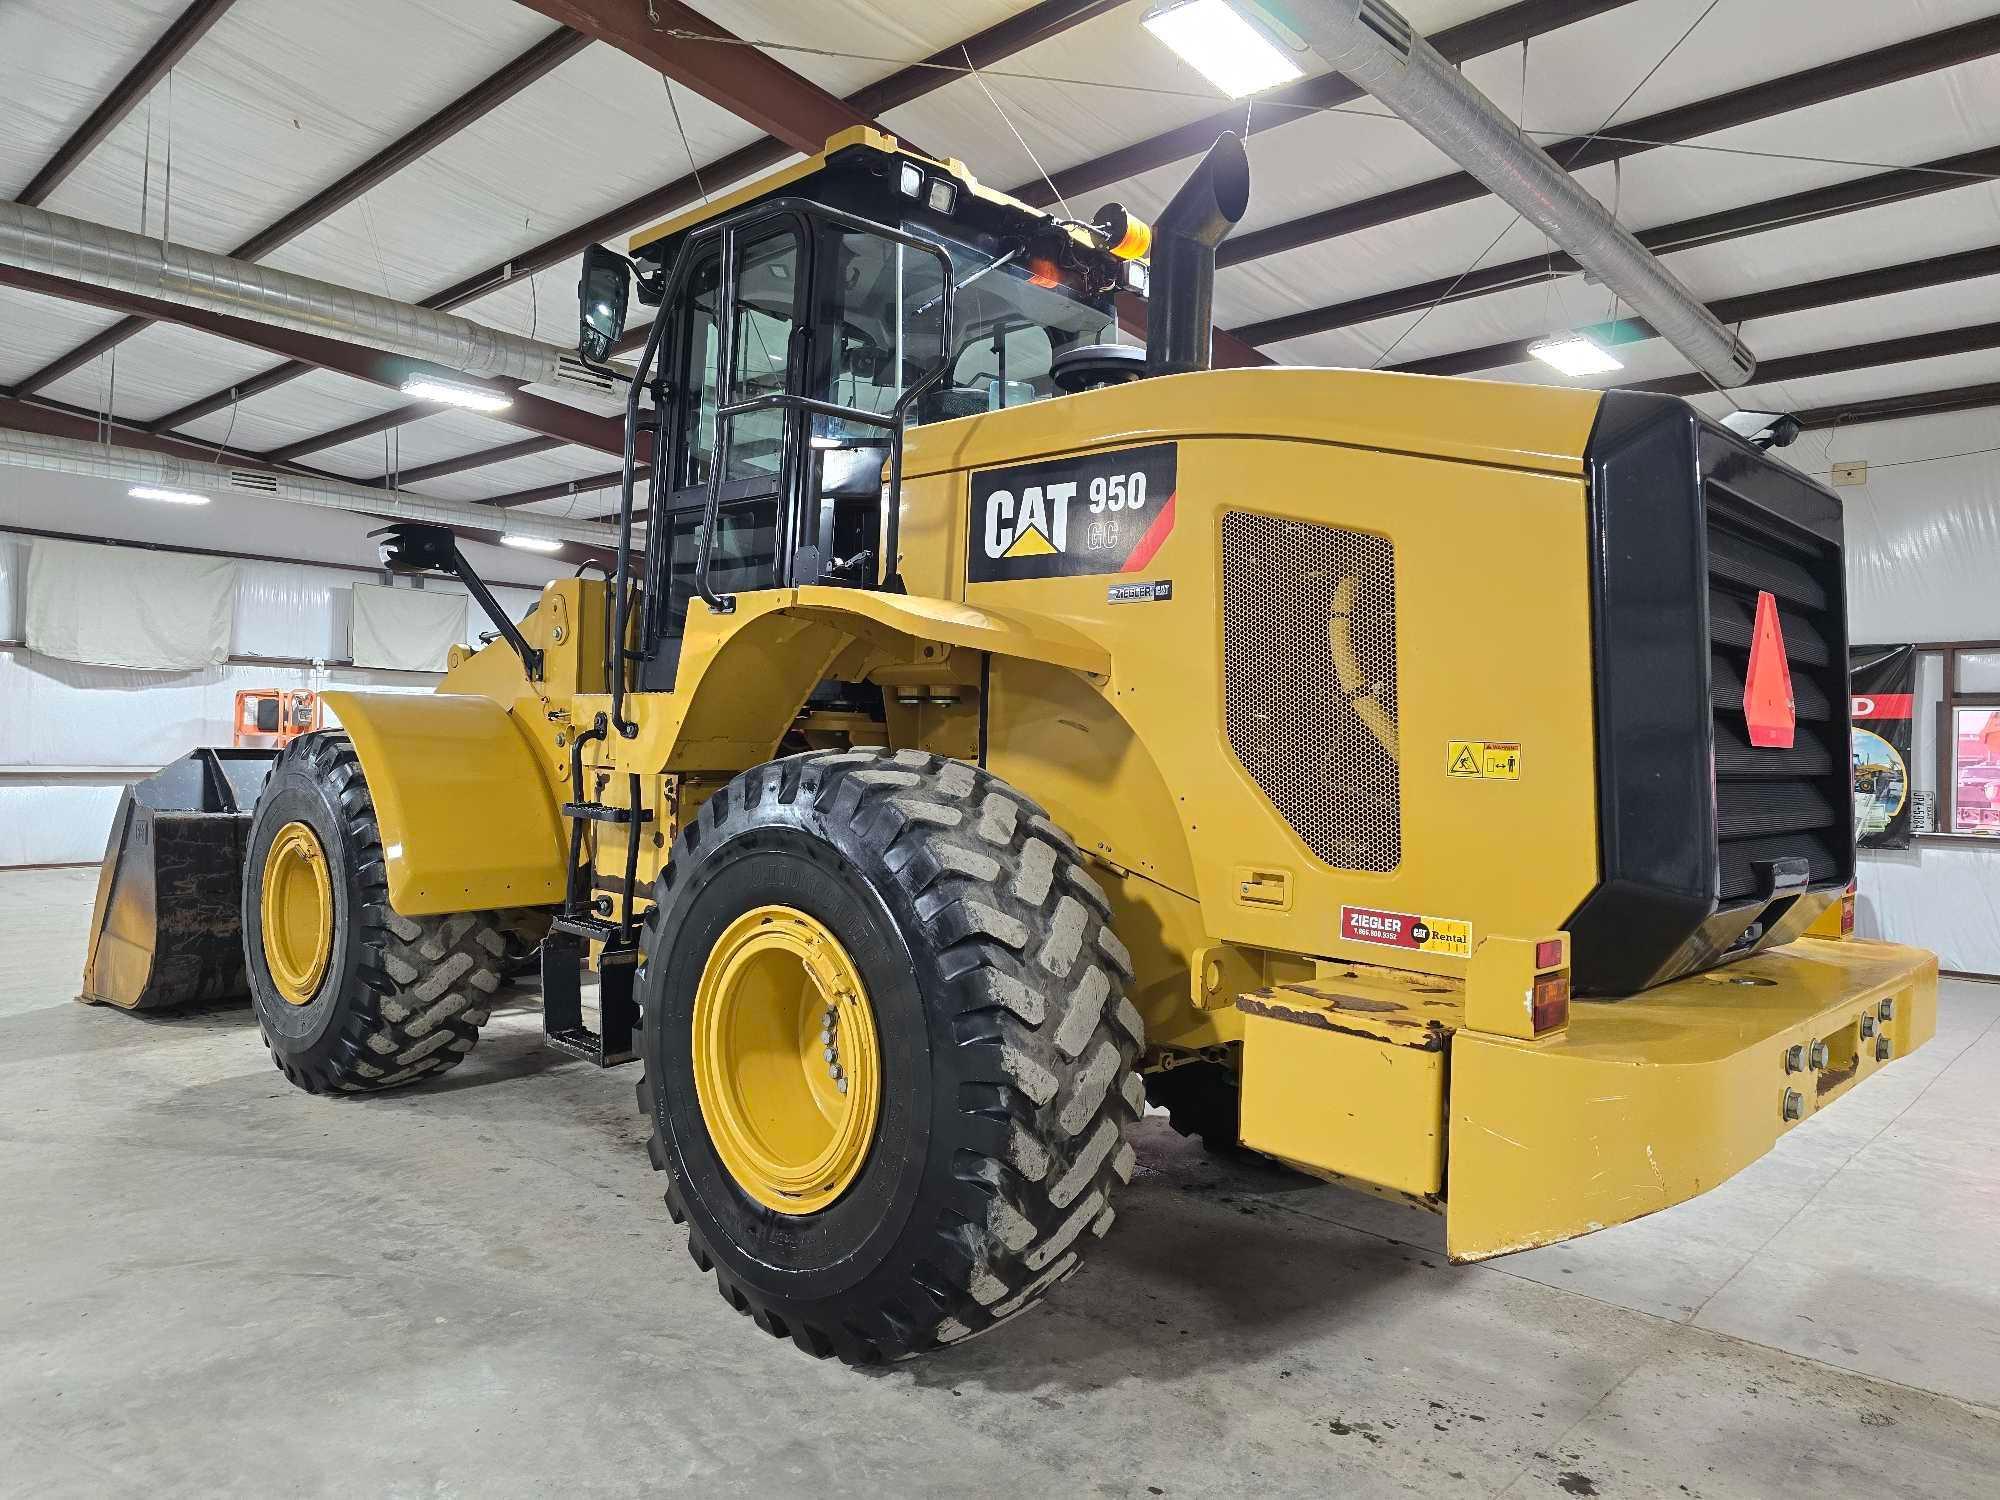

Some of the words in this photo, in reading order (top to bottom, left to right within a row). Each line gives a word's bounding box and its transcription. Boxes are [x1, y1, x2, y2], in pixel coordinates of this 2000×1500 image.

[984, 482, 1077, 559] CAT
[1089, 472, 1147, 513] 950
[1087, 520, 1119, 550] GC
[1115, 587, 1151, 599] ZIEGLER
[1155, 585, 1169, 596] CAT
[1350, 914, 1401, 932] ZIEGLER
[1413, 928, 1427, 938] CAT
[1431, 931, 1467, 944] Rental
